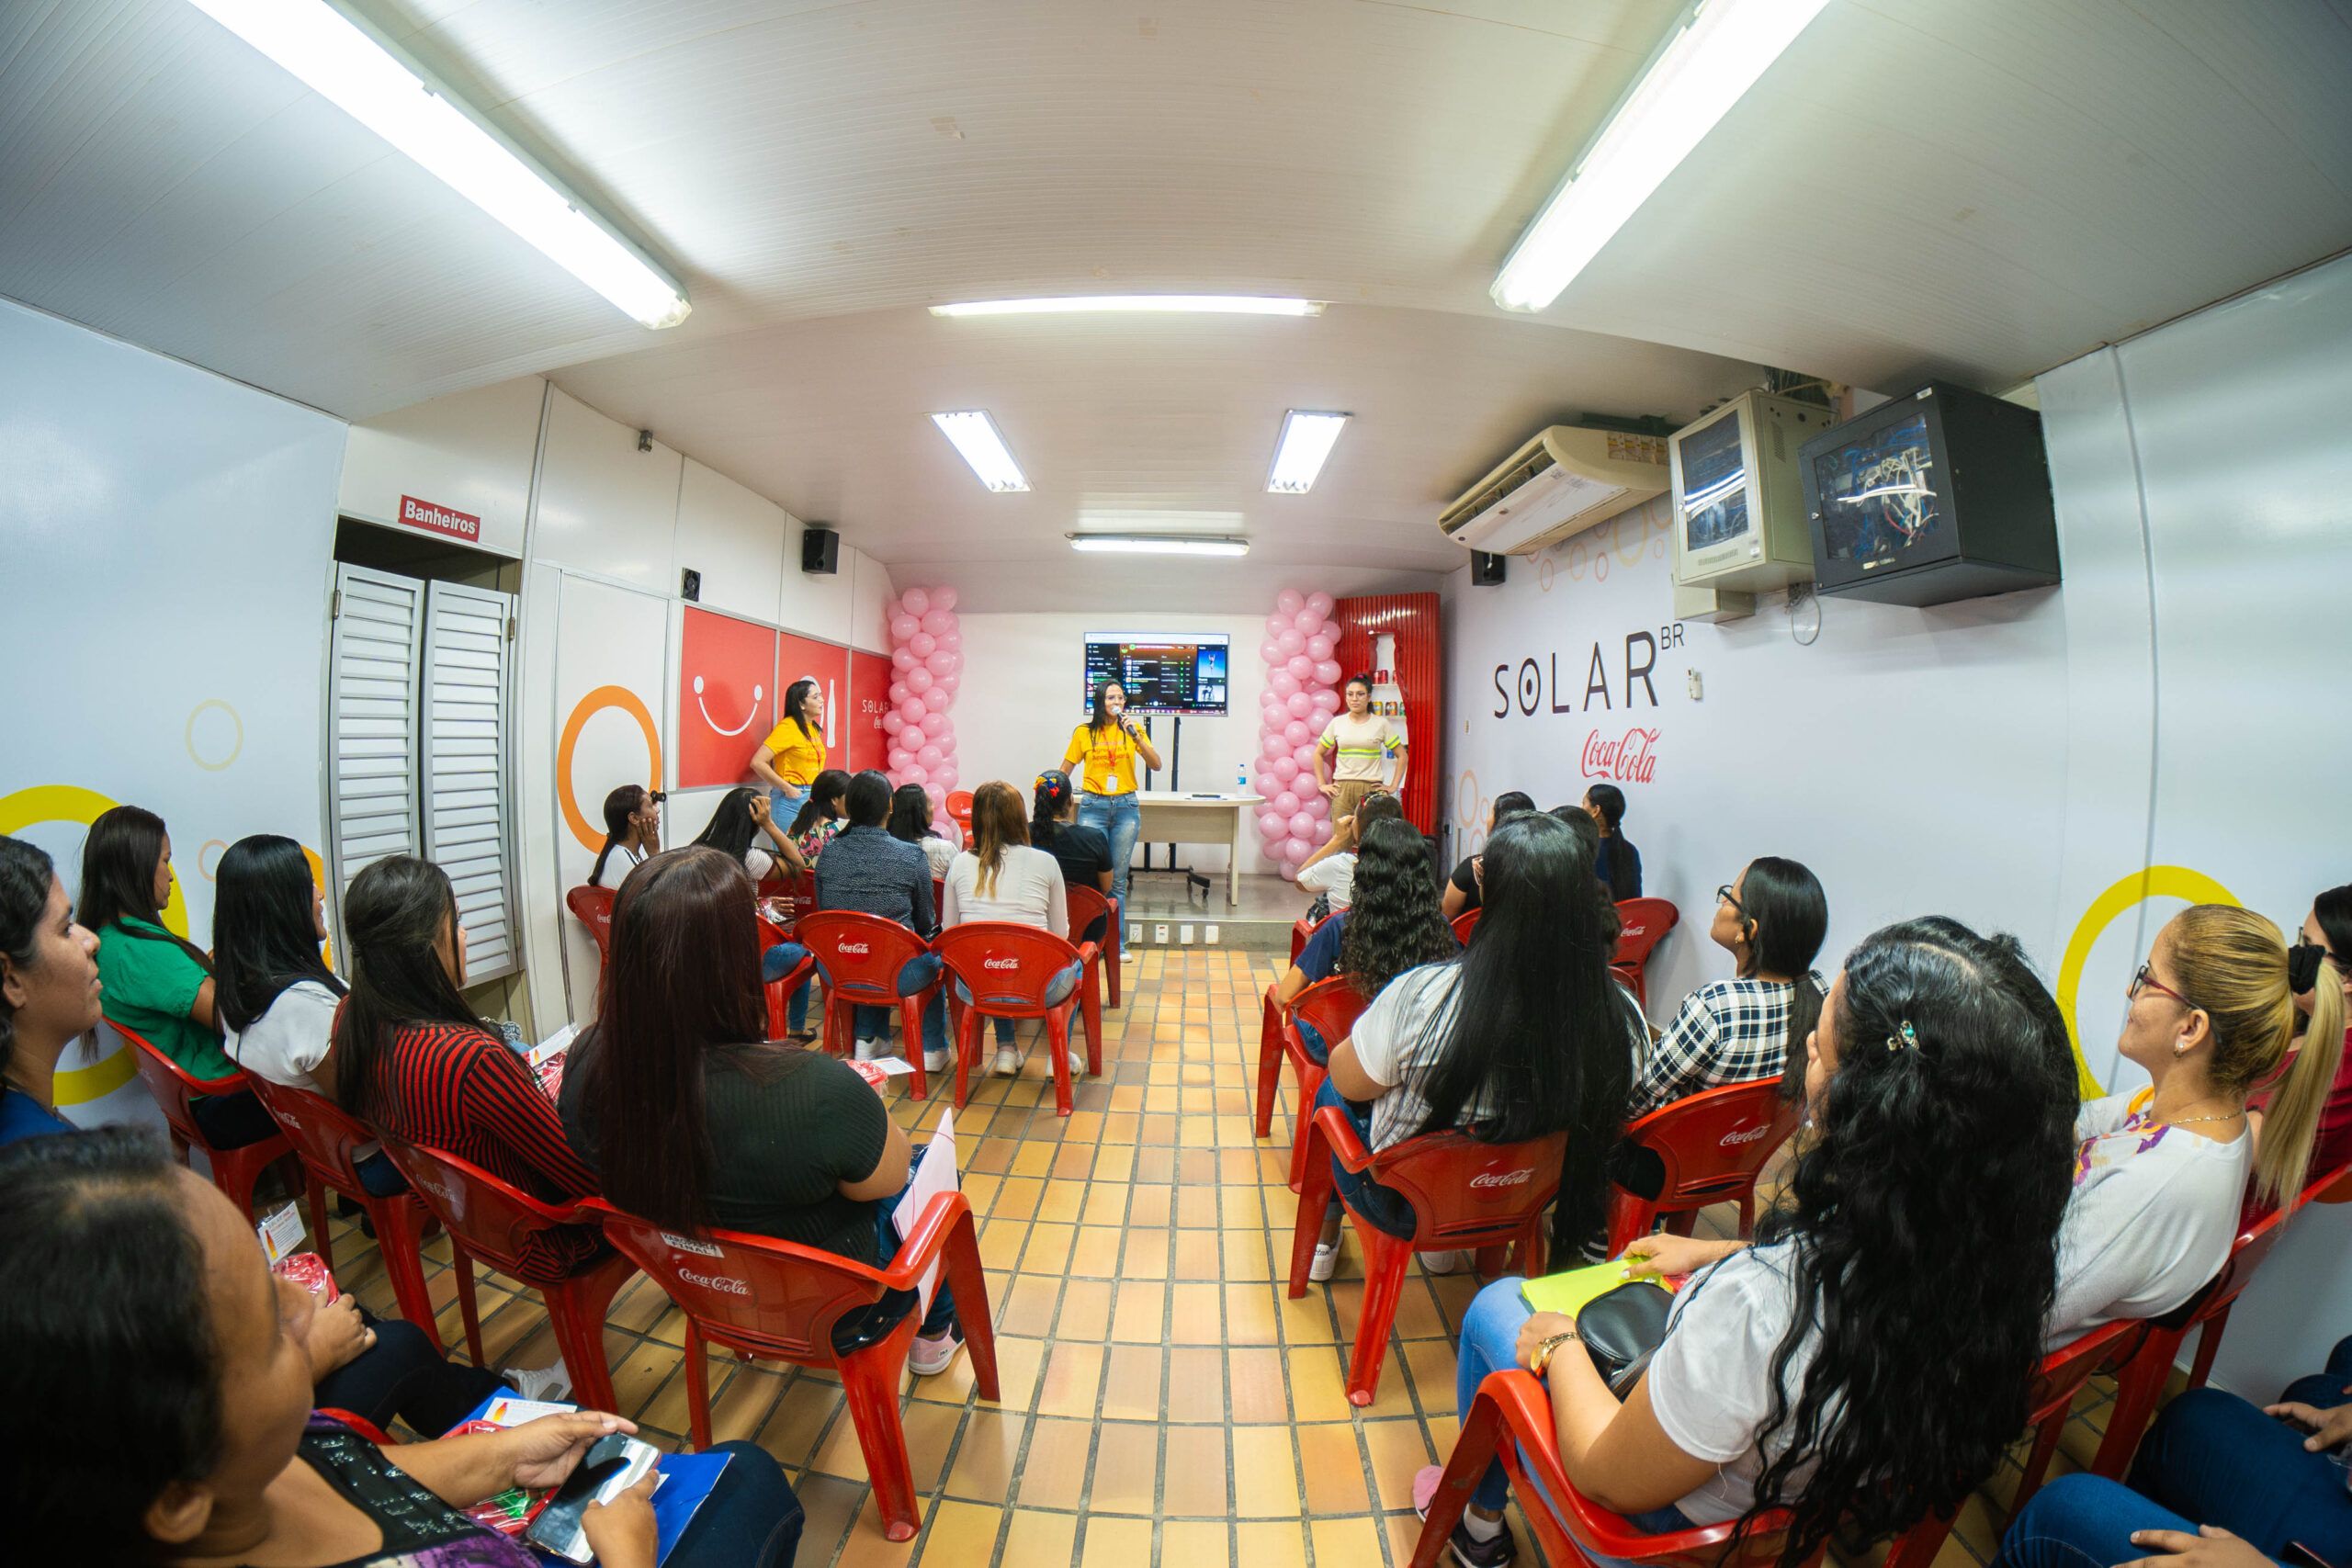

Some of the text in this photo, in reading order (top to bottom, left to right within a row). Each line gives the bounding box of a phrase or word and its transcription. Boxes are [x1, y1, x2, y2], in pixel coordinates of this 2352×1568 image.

[404, 500, 476, 535] Banheiros
[1494, 623, 1684, 719] SOLAR BR
[1581, 728, 1662, 784] Coca-Cola
[838, 942, 870, 953] Coca-Cola
[984, 958, 1019, 969] Coca-Cola
[1470, 1168, 1535, 1189] Coca-Cola
[678, 1268, 752, 1296] Coca-Cola
